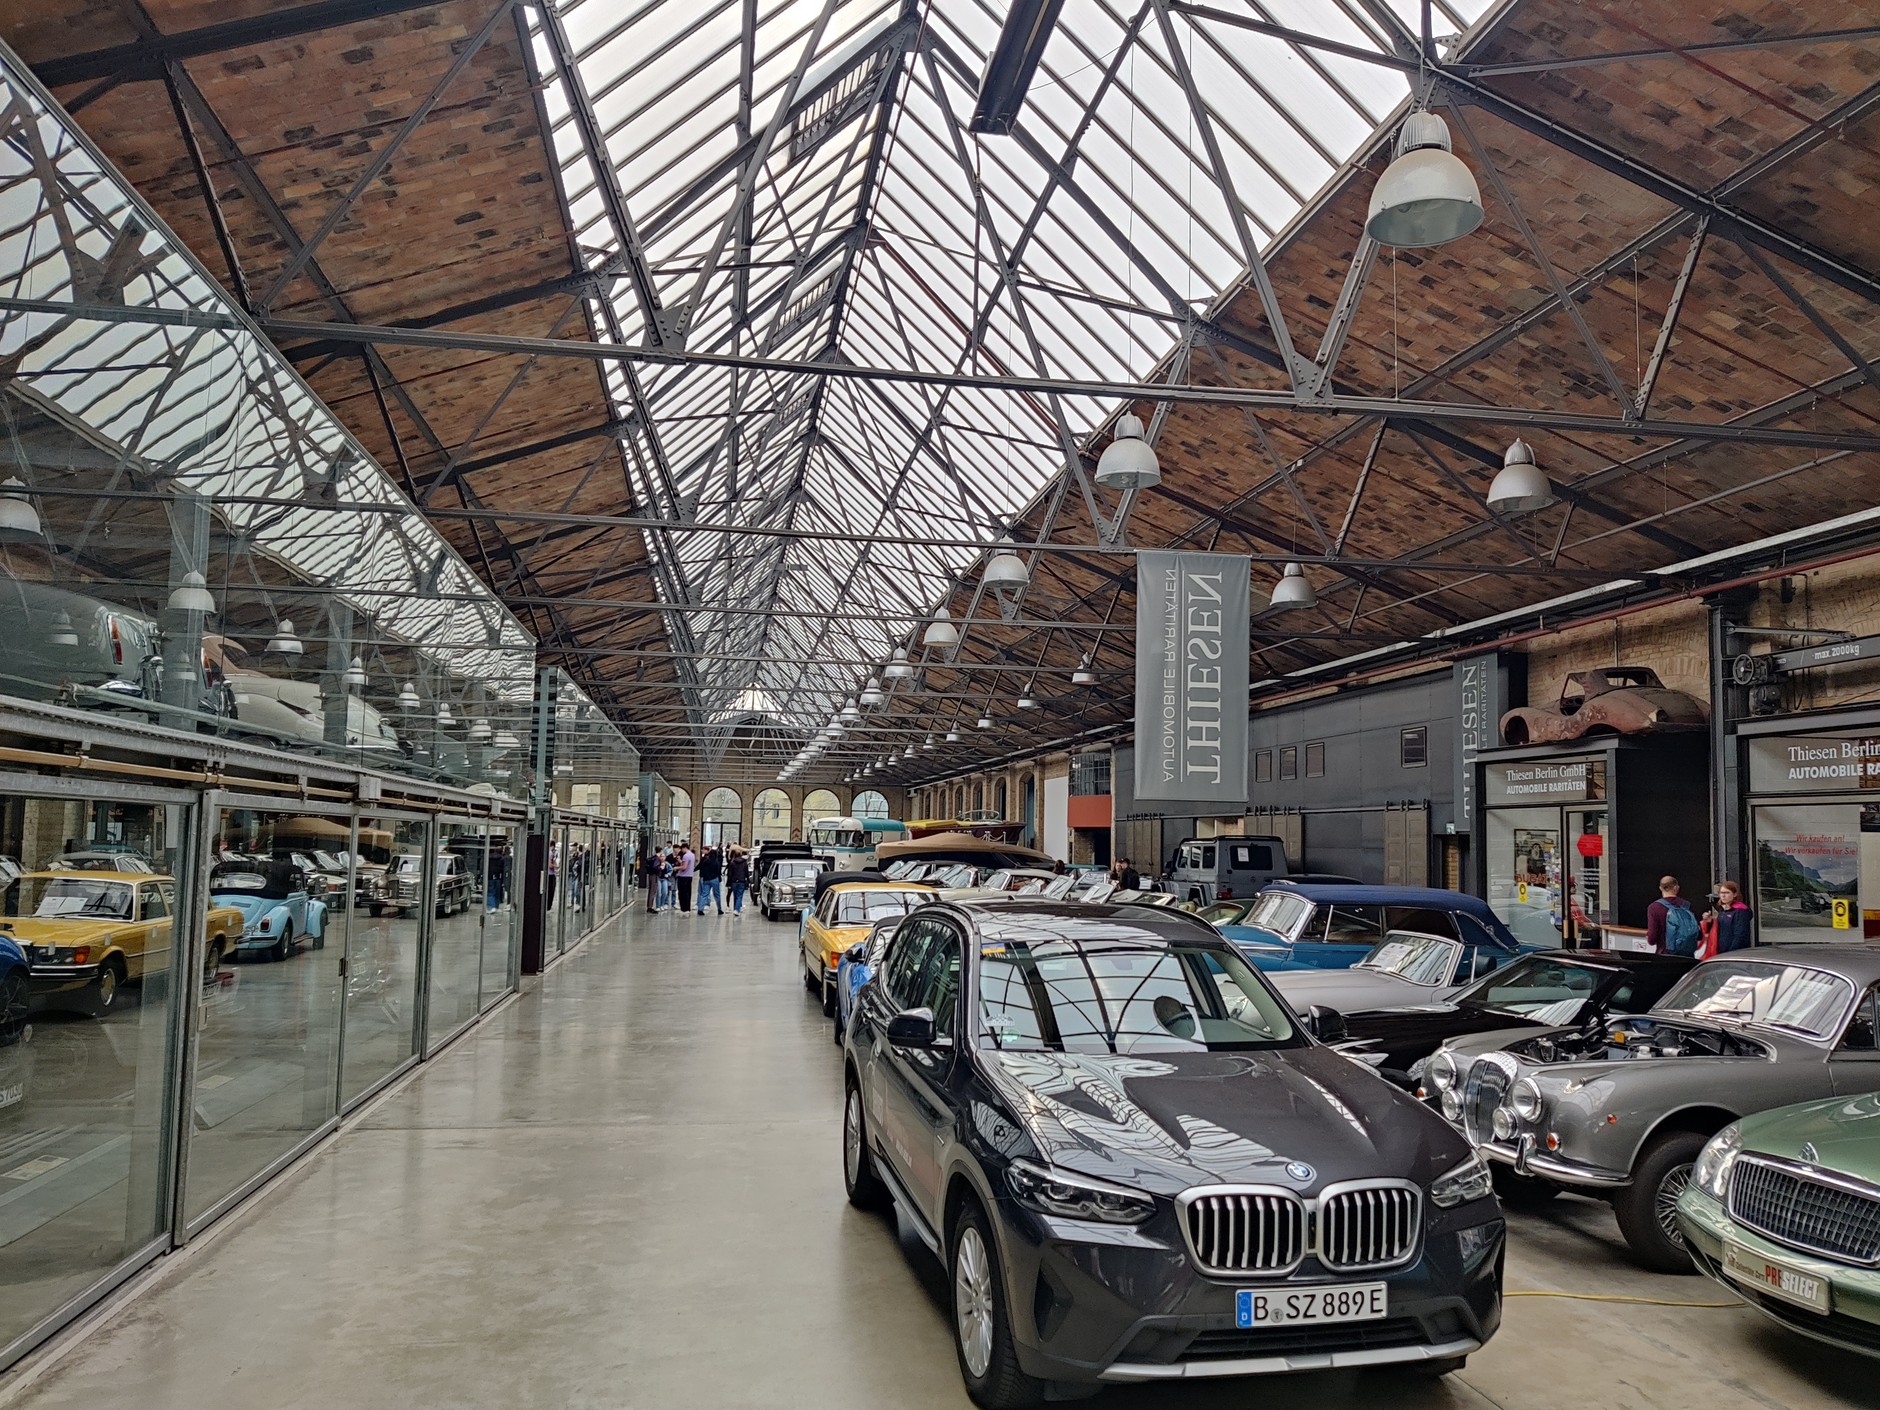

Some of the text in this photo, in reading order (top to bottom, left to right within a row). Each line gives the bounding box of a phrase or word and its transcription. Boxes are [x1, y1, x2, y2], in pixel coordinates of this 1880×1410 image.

[1480, 660, 1488, 729] RARITÄTEN
[1788, 746, 1838, 762] Thiesen
[1506, 763, 1586, 782] Thiesen Berlin GmbH
[1788, 763, 1864, 780] AUTOMOBILE
[1506, 780, 1586, 795] AUTOMOBILE RARITÄTEN
[1795, 834, 1807, 843] Wir
[1808, 834, 1831, 843] kaufen
[1785, 846, 1797, 854] Wir
[1798, 846, 1831, 855] verkaufen
[1253, 1296, 1269, 1321] B
[1286, 1294, 1317, 1319] SZ
